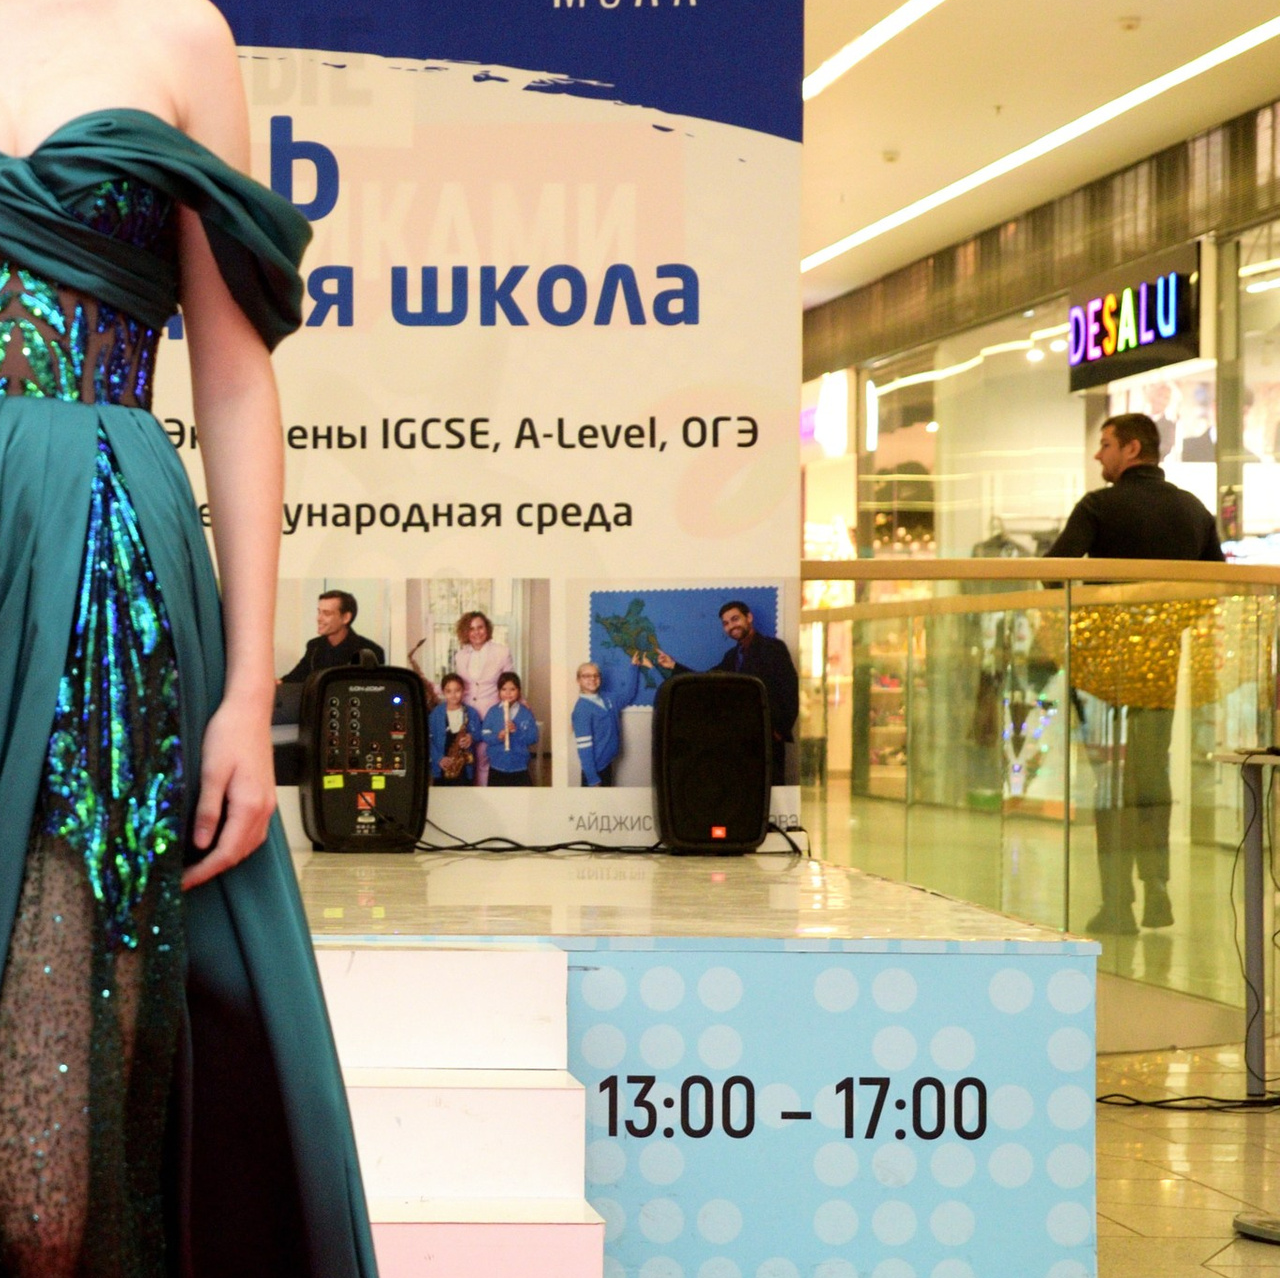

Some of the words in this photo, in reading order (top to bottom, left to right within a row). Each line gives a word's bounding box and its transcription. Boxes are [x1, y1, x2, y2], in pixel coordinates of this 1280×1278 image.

[390, 263, 700, 327] школа
[1068, 271, 1177, 366] DESALU
[382, 417, 501, 453] IGCSE,
[514, 416, 667, 452] A-Level,
[682, 415, 759, 449] ОГЭ
[516, 502, 633, 535] среда
[599, 1075, 755, 1139] 13:00
[835, 1076, 987, 1141] 17:00
